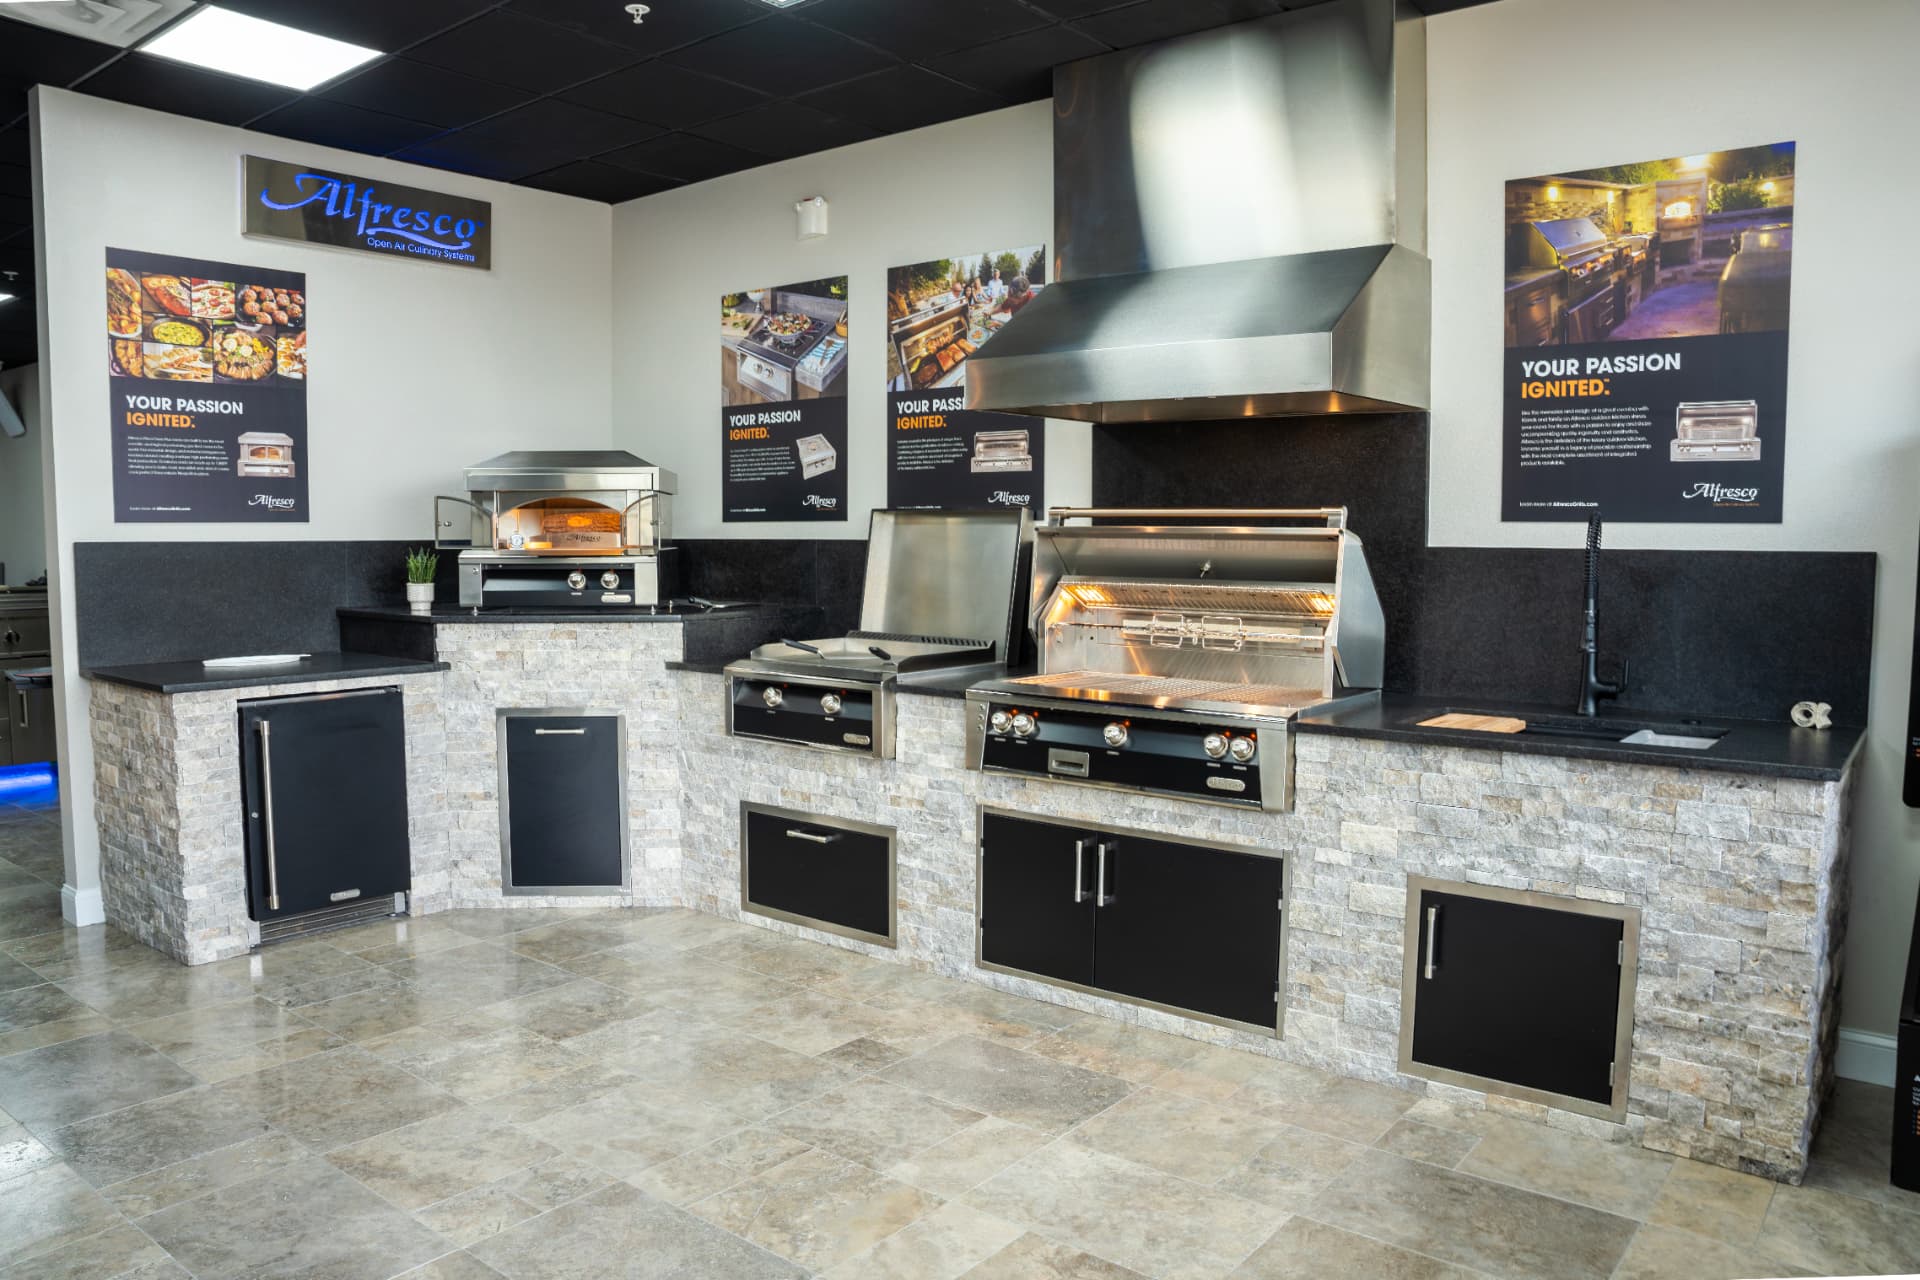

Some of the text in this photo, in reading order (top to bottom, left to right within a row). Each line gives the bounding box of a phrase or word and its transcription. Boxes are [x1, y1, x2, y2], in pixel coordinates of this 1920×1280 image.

[260, 173, 477, 249] Alfresco
[367, 237, 475, 262] Open Air Culinary Systems
[1522, 353, 1681, 378] YOUR PASSION
[126, 394, 244, 415] YOUR PASSION
[896, 396, 965, 415] YOUR PASSI
[729, 409, 801, 427] YOUR PASSION
[248, 494, 295, 508] Alfresco
[987, 490, 1030, 505] Alfresco
[1683, 482, 1758, 502] Alfresco
